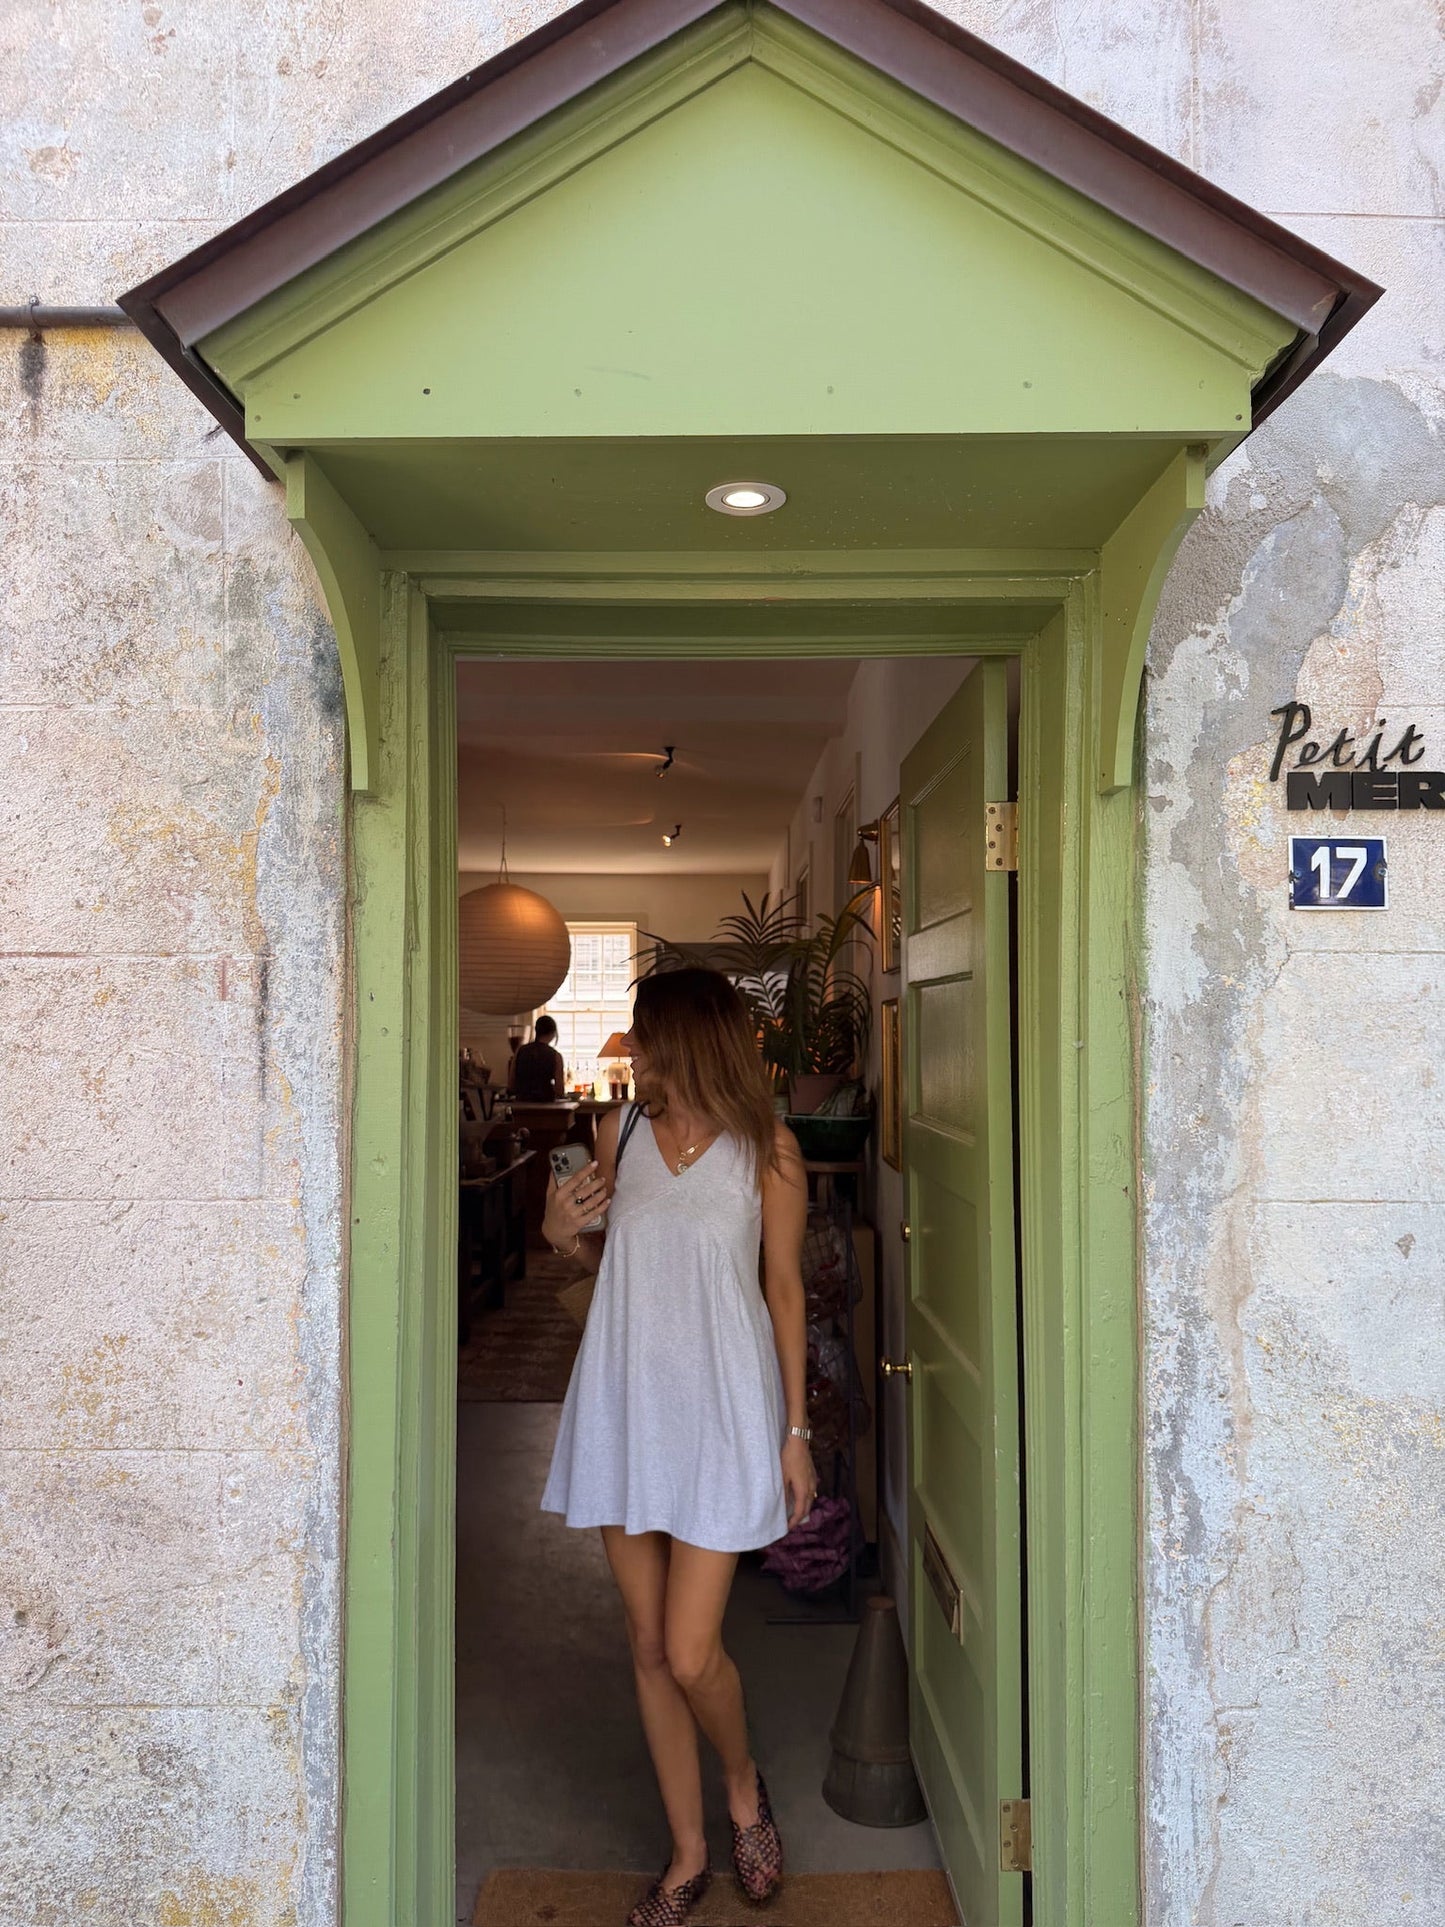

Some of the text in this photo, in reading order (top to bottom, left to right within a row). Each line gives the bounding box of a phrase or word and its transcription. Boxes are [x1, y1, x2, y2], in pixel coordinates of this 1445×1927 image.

[1270, 701, 1425, 782] Petit
[1287, 772, 1445, 810] MER
[1311, 846, 1367, 898] 17
